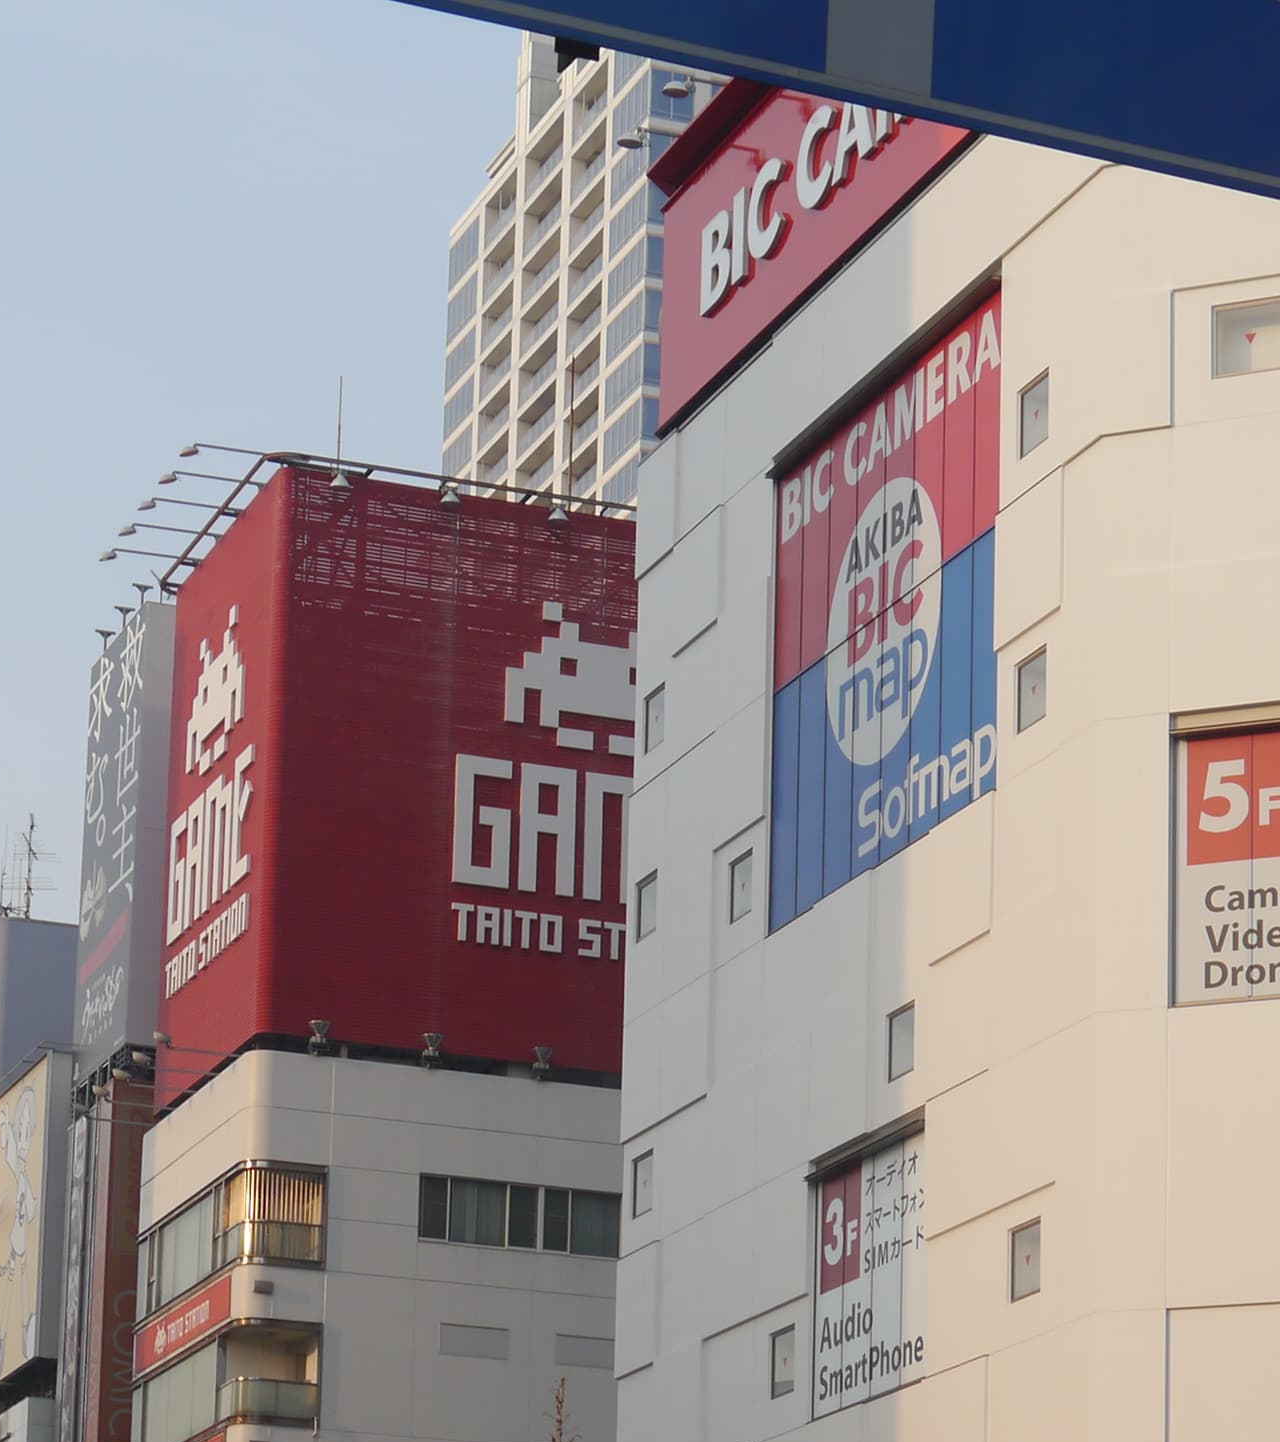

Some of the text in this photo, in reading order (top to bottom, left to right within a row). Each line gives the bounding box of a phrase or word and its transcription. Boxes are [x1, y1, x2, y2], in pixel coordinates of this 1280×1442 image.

[699, 103, 915, 318] BIC CA
[781, 308, 1001, 544] BIC CAMERA
[845, 487, 923, 583] AKIBA
[845, 539, 925, 669] BIC
[837, 626, 929, 743] map
[857, 722, 997, 859] Sofmap
[166, 743, 256, 947] GAME
[165, 892, 249, 999] TAITO STATION
[451, 902, 563, 953] TAITO
[823, 1197, 858, 1266] 3F
[864, 1225, 925, 1274] SIMカード
[819, 1302, 873, 1353] Audio
[819, 1335, 924, 1401] SmartPhone
